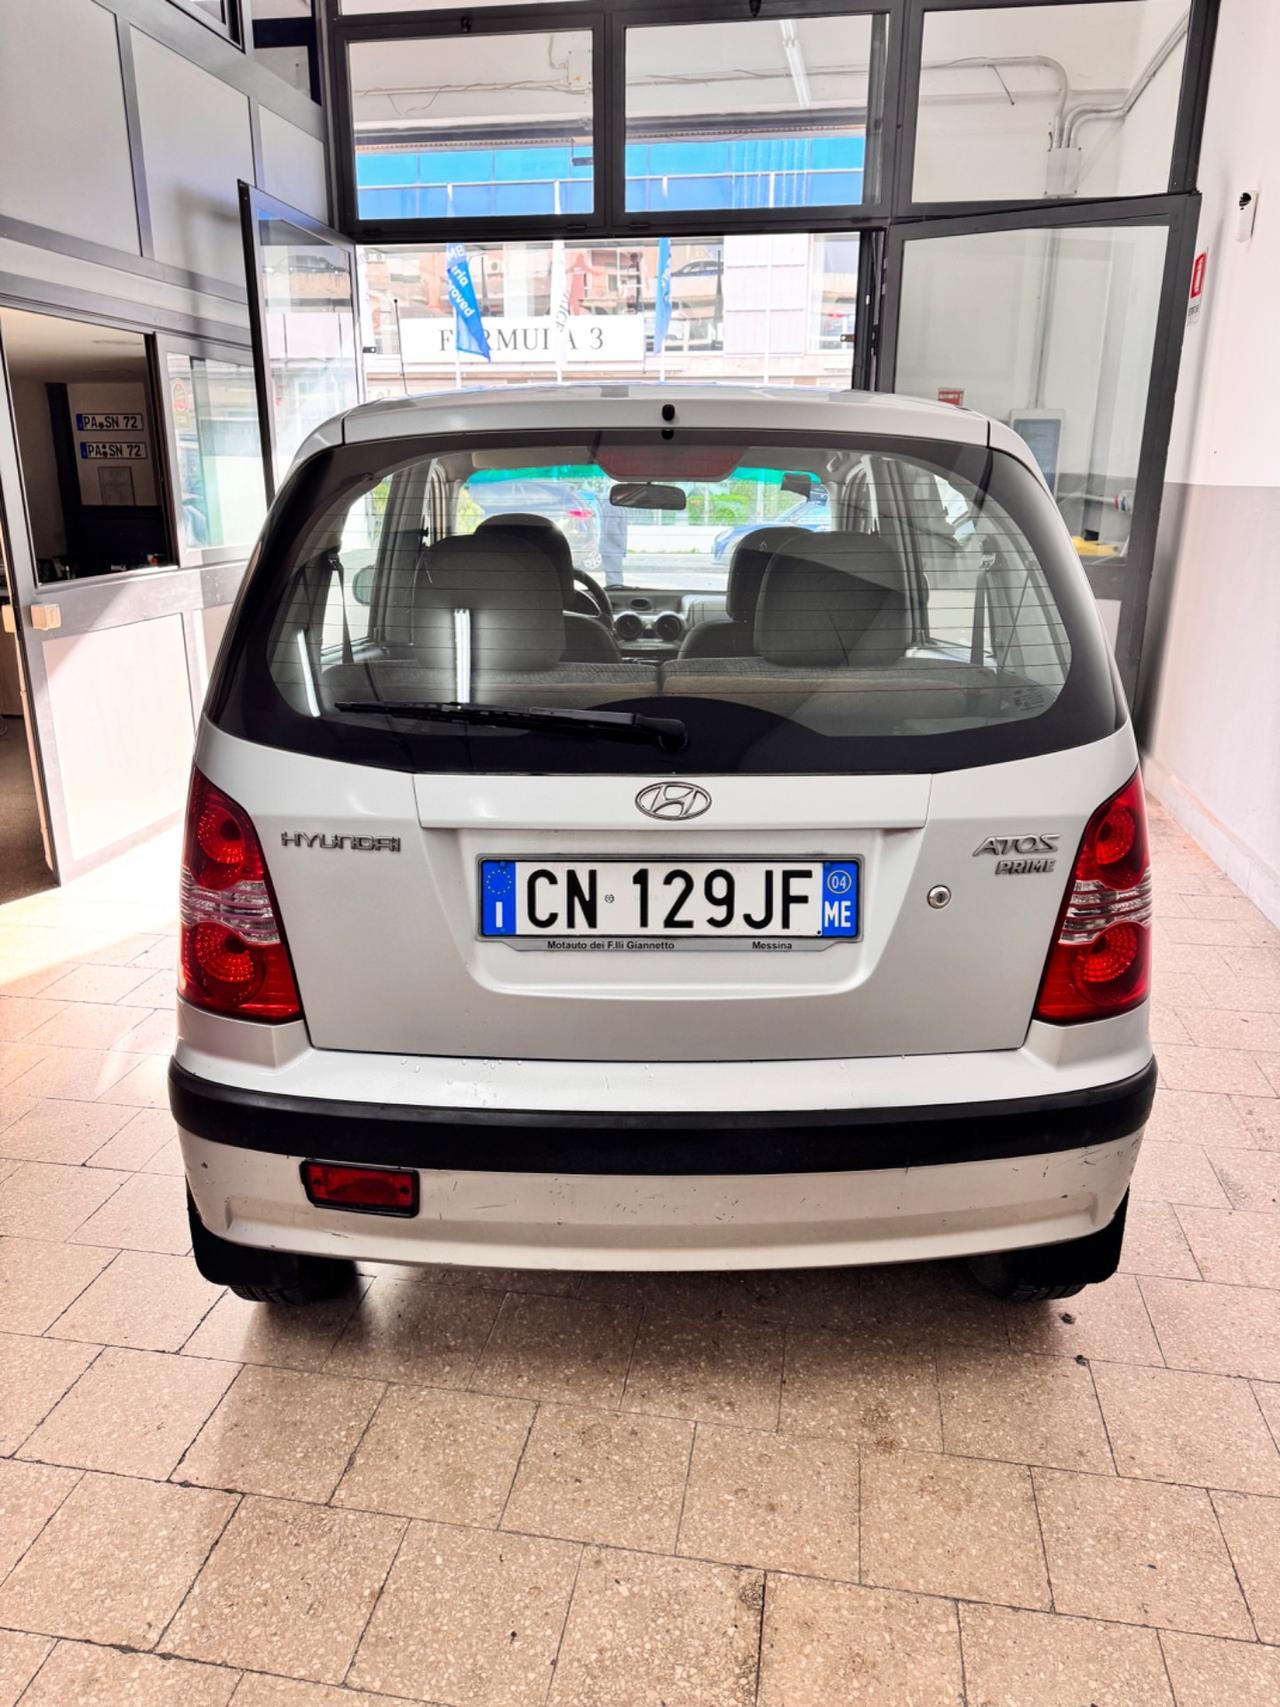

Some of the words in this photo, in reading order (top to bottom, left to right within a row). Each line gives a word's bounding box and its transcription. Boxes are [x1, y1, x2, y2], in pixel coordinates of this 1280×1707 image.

[589, 326, 604, 351] 3
[123, 416, 138, 429] 72
[127, 445, 142, 457] 72
[280, 831, 401, 853] HYUNDAI
[972, 833, 1061, 857] ATOS
[994, 859, 1057, 875] PRIME
[831, 875, 847, 890] 04
[527, 868, 598, 929] CN
[824, 900, 852, 928] ME
[547, 941, 587, 950] Motauto
[589, 941, 605, 950] dei
[626, 941, 675, 950] Giannetto
[752, 941, 793, 950] Messina
